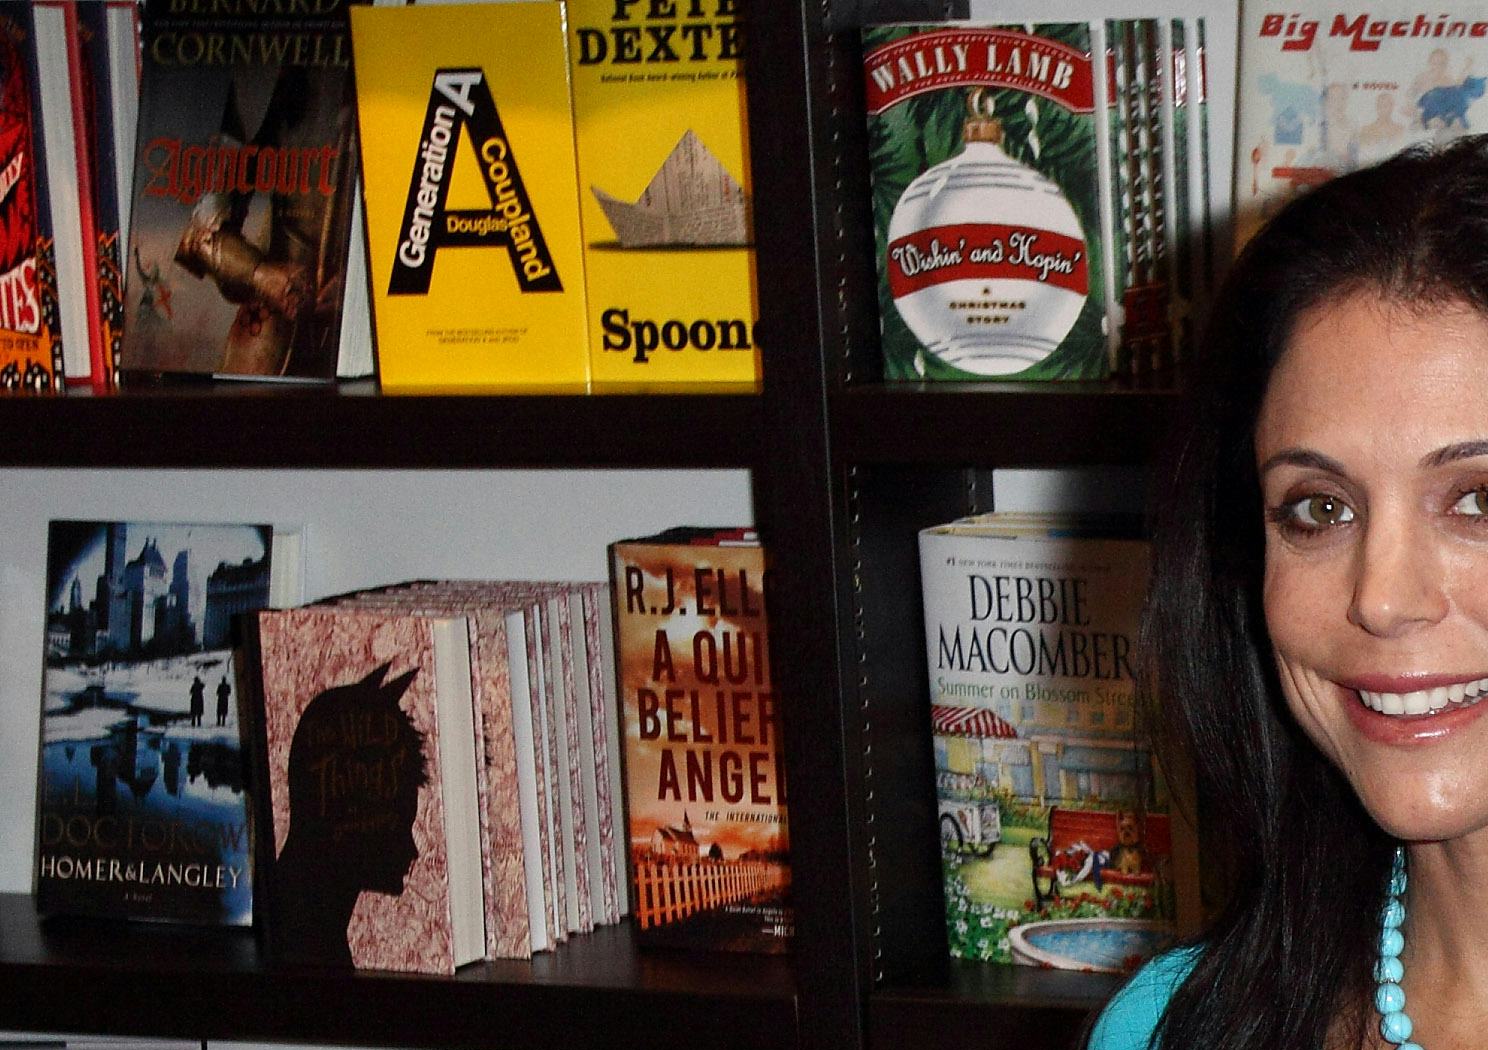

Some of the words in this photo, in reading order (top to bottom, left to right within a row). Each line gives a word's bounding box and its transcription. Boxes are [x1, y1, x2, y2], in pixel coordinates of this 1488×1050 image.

[152, 32, 351, 67] CORNWELL
[1258, 13, 1318, 51] Big
[870, 43, 969, 93] WALLY
[986, 43, 1074, 90] LAMB
[142, 137, 339, 204] Agincourt
[399, 105, 456, 268] Generation
[447, 216, 508, 237] Douglas
[481, 136, 550, 283] Coupland
[892, 238, 966, 277] Wishin'
[969, 239, 1004, 263] and
[1009, 232, 1082, 281] Hopin'
[626, 566, 686, 615] R.J.
[969, 574, 1090, 626] DEBBIE
[652, 630, 676, 682] A
[938, 623, 1138, 680] MACOMBER
[938, 677, 994, 698] Summer
[1000, 684, 1019, 699] on
[1025, 683, 1089, 701] Blossom
[41, 854, 243, 889] HOMER&LANGLEY
